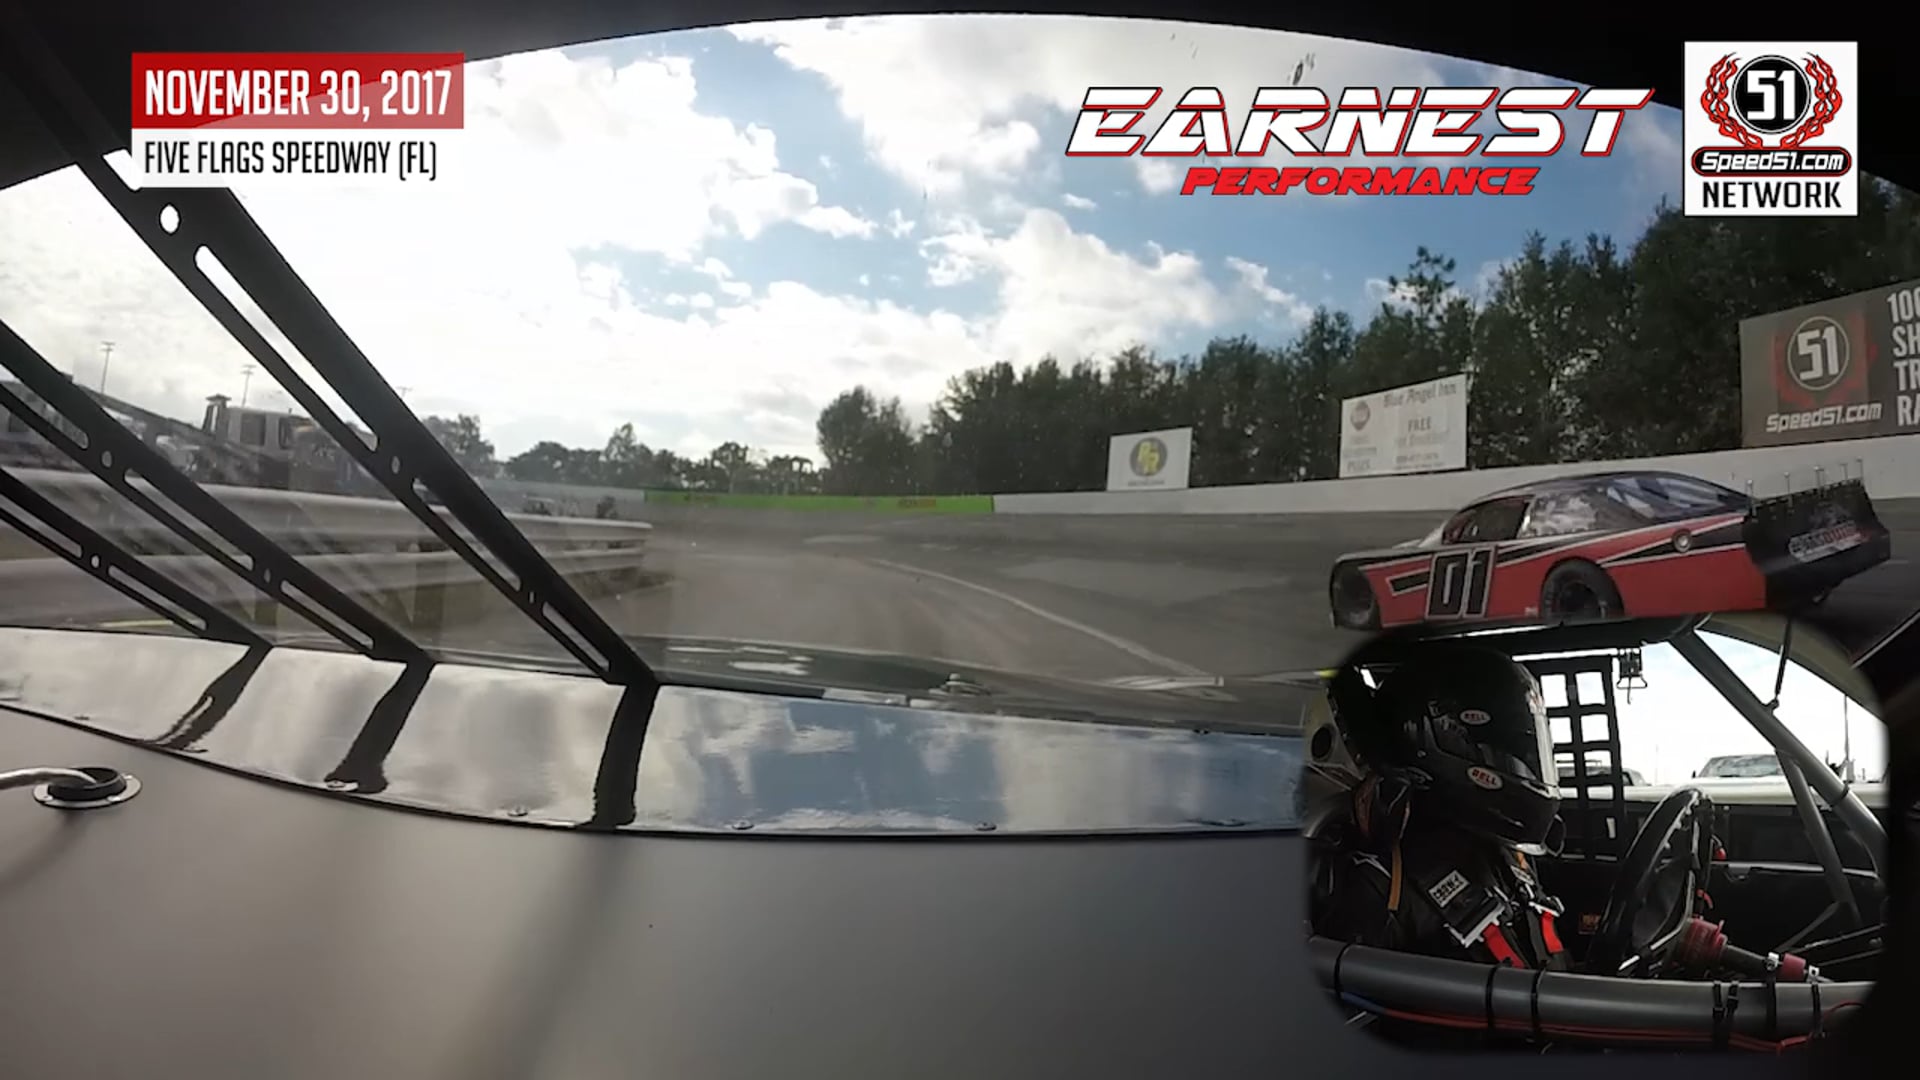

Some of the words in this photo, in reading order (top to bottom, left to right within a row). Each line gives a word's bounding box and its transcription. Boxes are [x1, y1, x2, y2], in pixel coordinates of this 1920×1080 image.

[1796, 325, 1840, 381] 51
[1407, 416, 1432, 432] FREE
[1765, 402, 1882, 434] Speed51.com
[1426, 546, 1495, 619] 01
[1471, 767, 1497, 786] BELL
